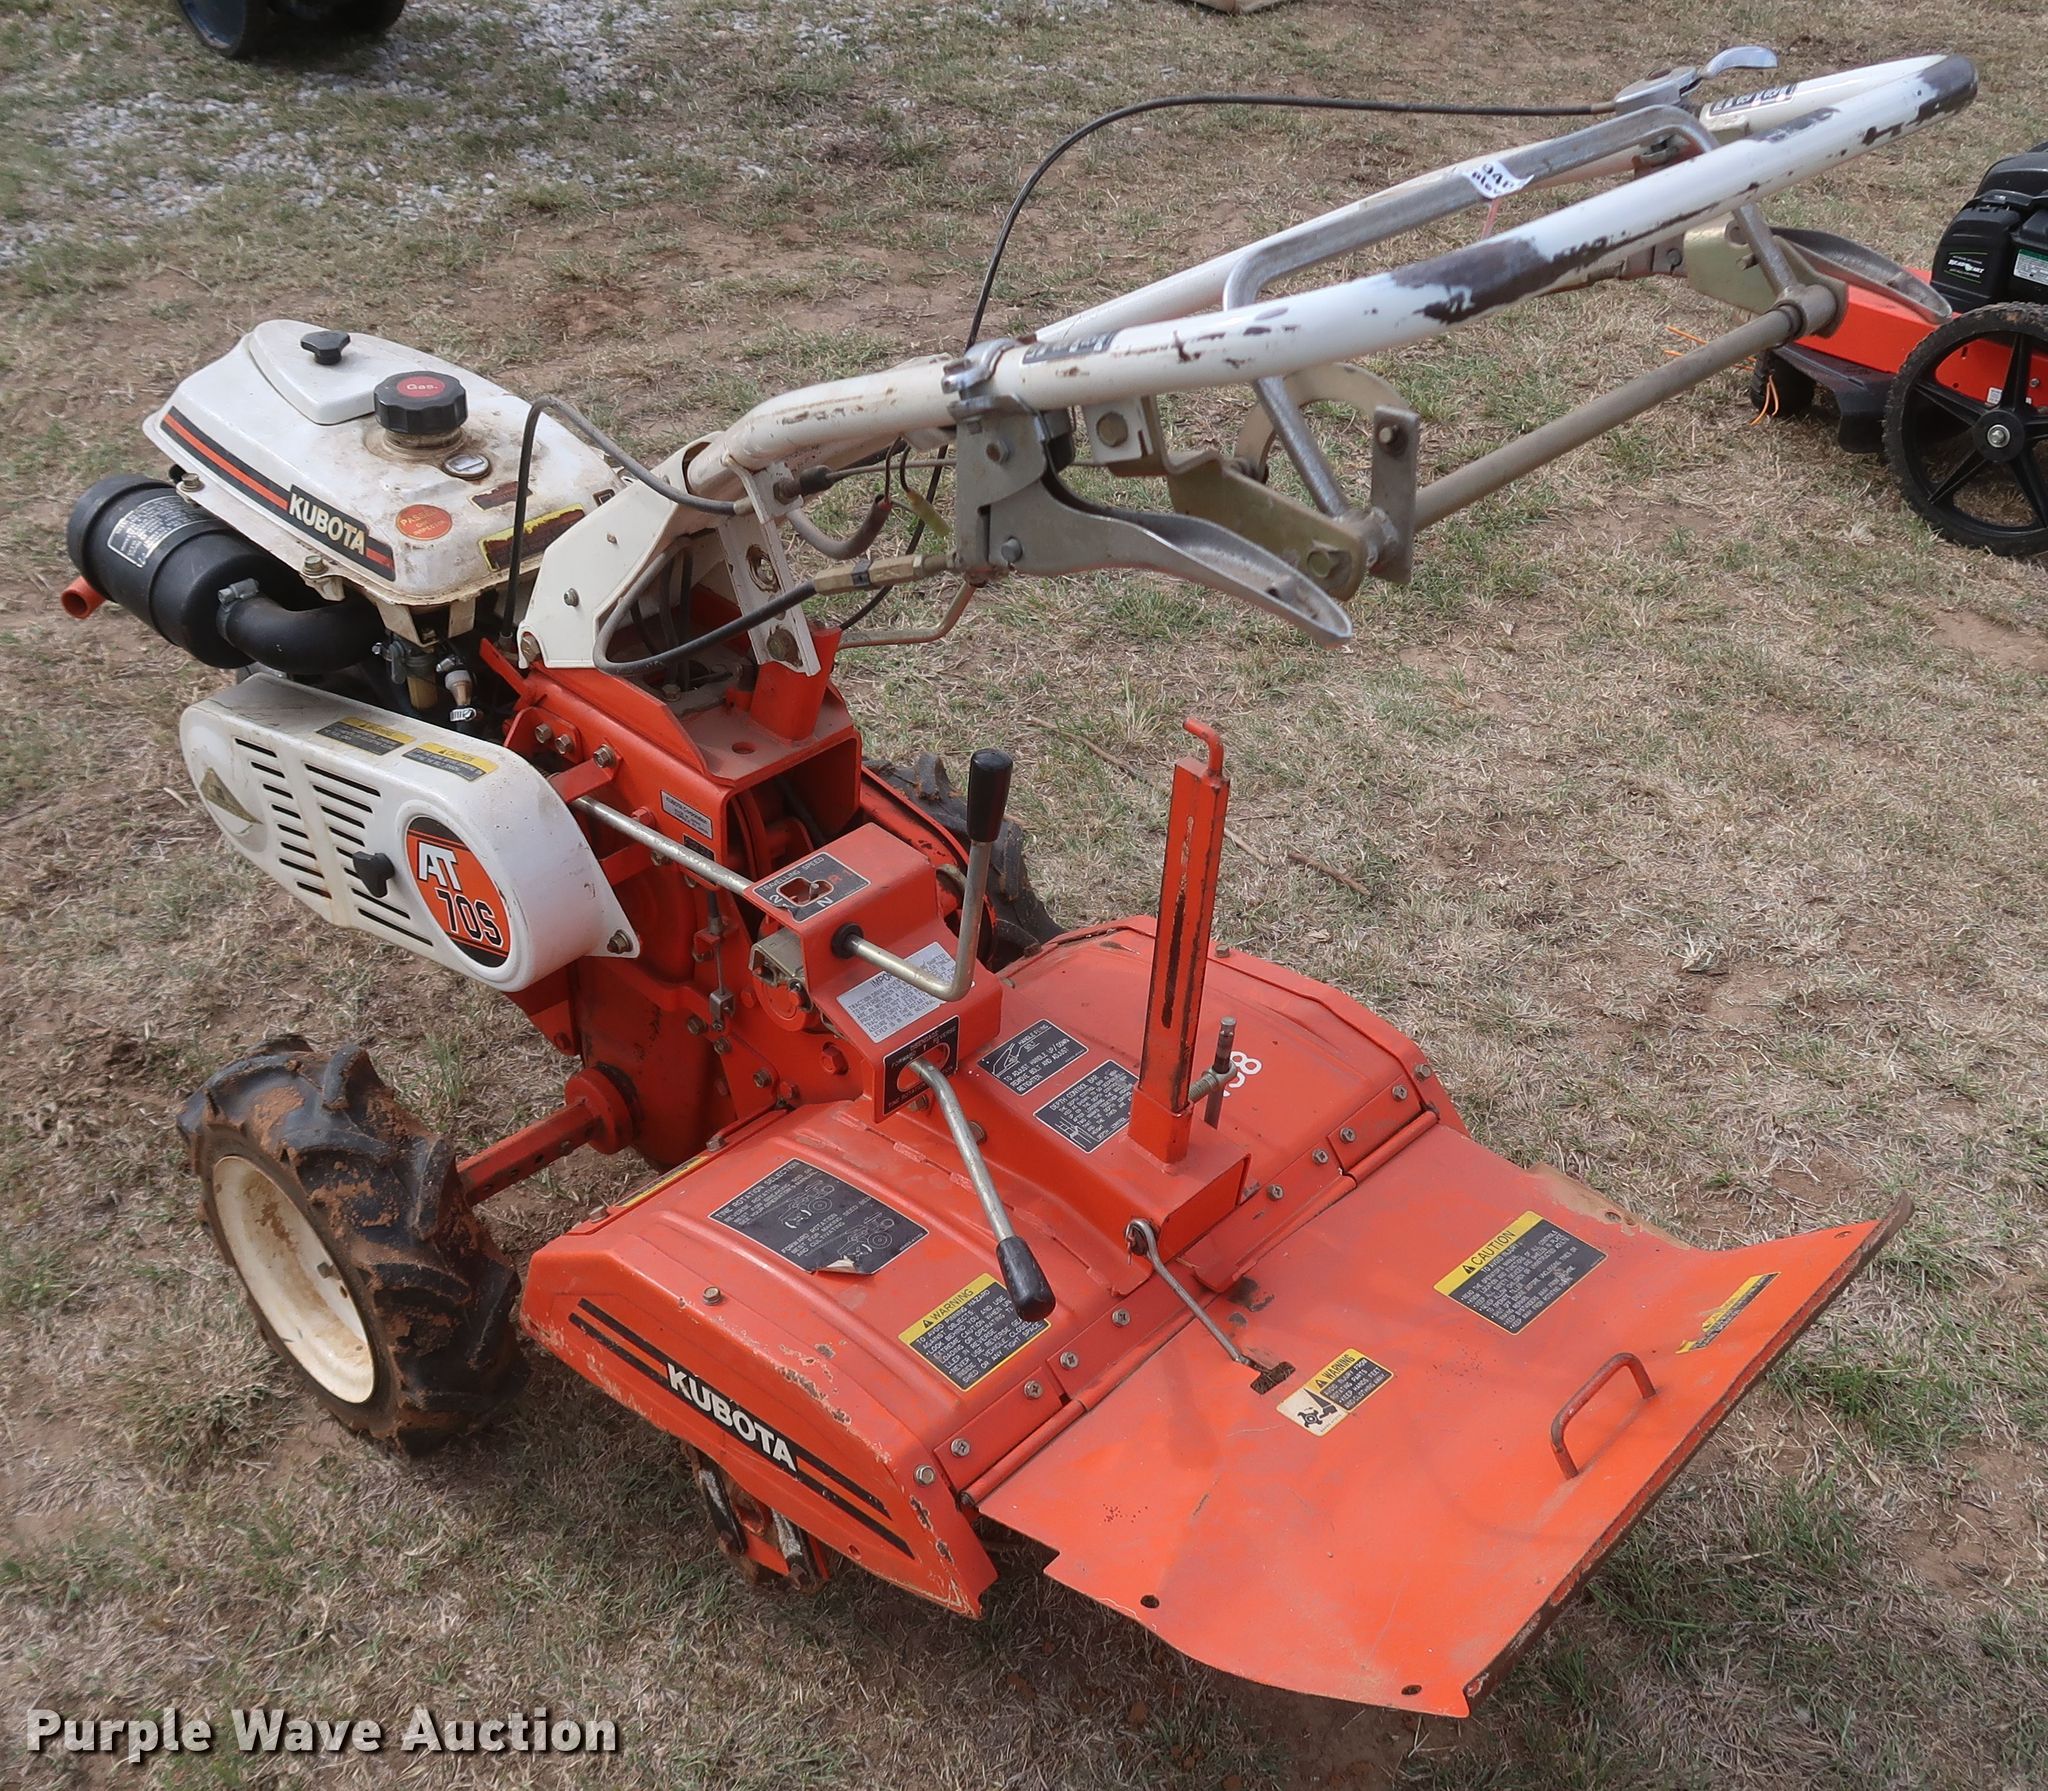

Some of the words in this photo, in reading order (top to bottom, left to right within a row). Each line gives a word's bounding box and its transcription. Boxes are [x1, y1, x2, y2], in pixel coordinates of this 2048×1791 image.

[288, 493, 366, 555] KUBOTA
[417, 840, 463, 892] AT
[758, 869, 801, 893] TRAVELLING
[800, 856, 825, 870] SPEED
[767, 893, 783, 903] 2
[816, 896, 834, 907] N
[435, 888, 505, 948] 70S
[1003, 1074, 1013, 1082] TO
[1010, 1063, 1030, 1077] ADJUST
[1008, 1072, 1030, 1087] REMOVE
[1050, 1046, 1070, 1060] ADJUST
[1048, 1096, 1068, 1110] DEPTH
[1065, 1082, 1088, 1098] CONTROL
[714, 1205, 735, 1218] TINE
[730, 1184, 766, 1207] ROTATION
[762, 1160, 801, 1185] SELECTION
[750, 1183, 781, 1203] ROTATION
[778, 1232, 810, 1253] FORWARD
[807, 1212, 839, 1233] ROTATION
[1468, 1229, 1517, 1266] CAUTION
[794, 1247, 810, 1257] AND
[1480, 1265, 1491, 1273] TO
[915, 1336, 927, 1345] TO
[925, 1322, 945, 1337] AVOID
[966, 1288, 991, 1307] HAZARD
[929, 1287, 974, 1321] WARNING
[944, 1324, 967, 1341] BEHIND
[965, 1314, 980, 1325] YOU
[979, 1304, 993, 1315] AND
[991, 1294, 1006, 1305] USE
[921, 1329, 947, 1350] AGAINST
[932, 1336, 961, 1359] EXTREME
[959, 1318, 986, 1338] CAUTION
[984, 1305, 1002, 1320] WHEN
[938, 1343, 964, 1363] LOADING
[963, 1336, 974, 1344] OR
[969, 1327, 997, 1349] REVERSE
[970, 1346, 984, 1358] USE
[983, 1325, 1011, 1347] REVERSE
[961, 1368, 979, 1383] SHED
[979, 1360, 990, 1369] OR
[989, 1350, 1003, 1361] ANY
[1003, 1336, 1022, 1350] TIGHT
[1320, 1353, 1355, 1380] WARNING
[667, 1362, 797, 1472] KUBOTA
